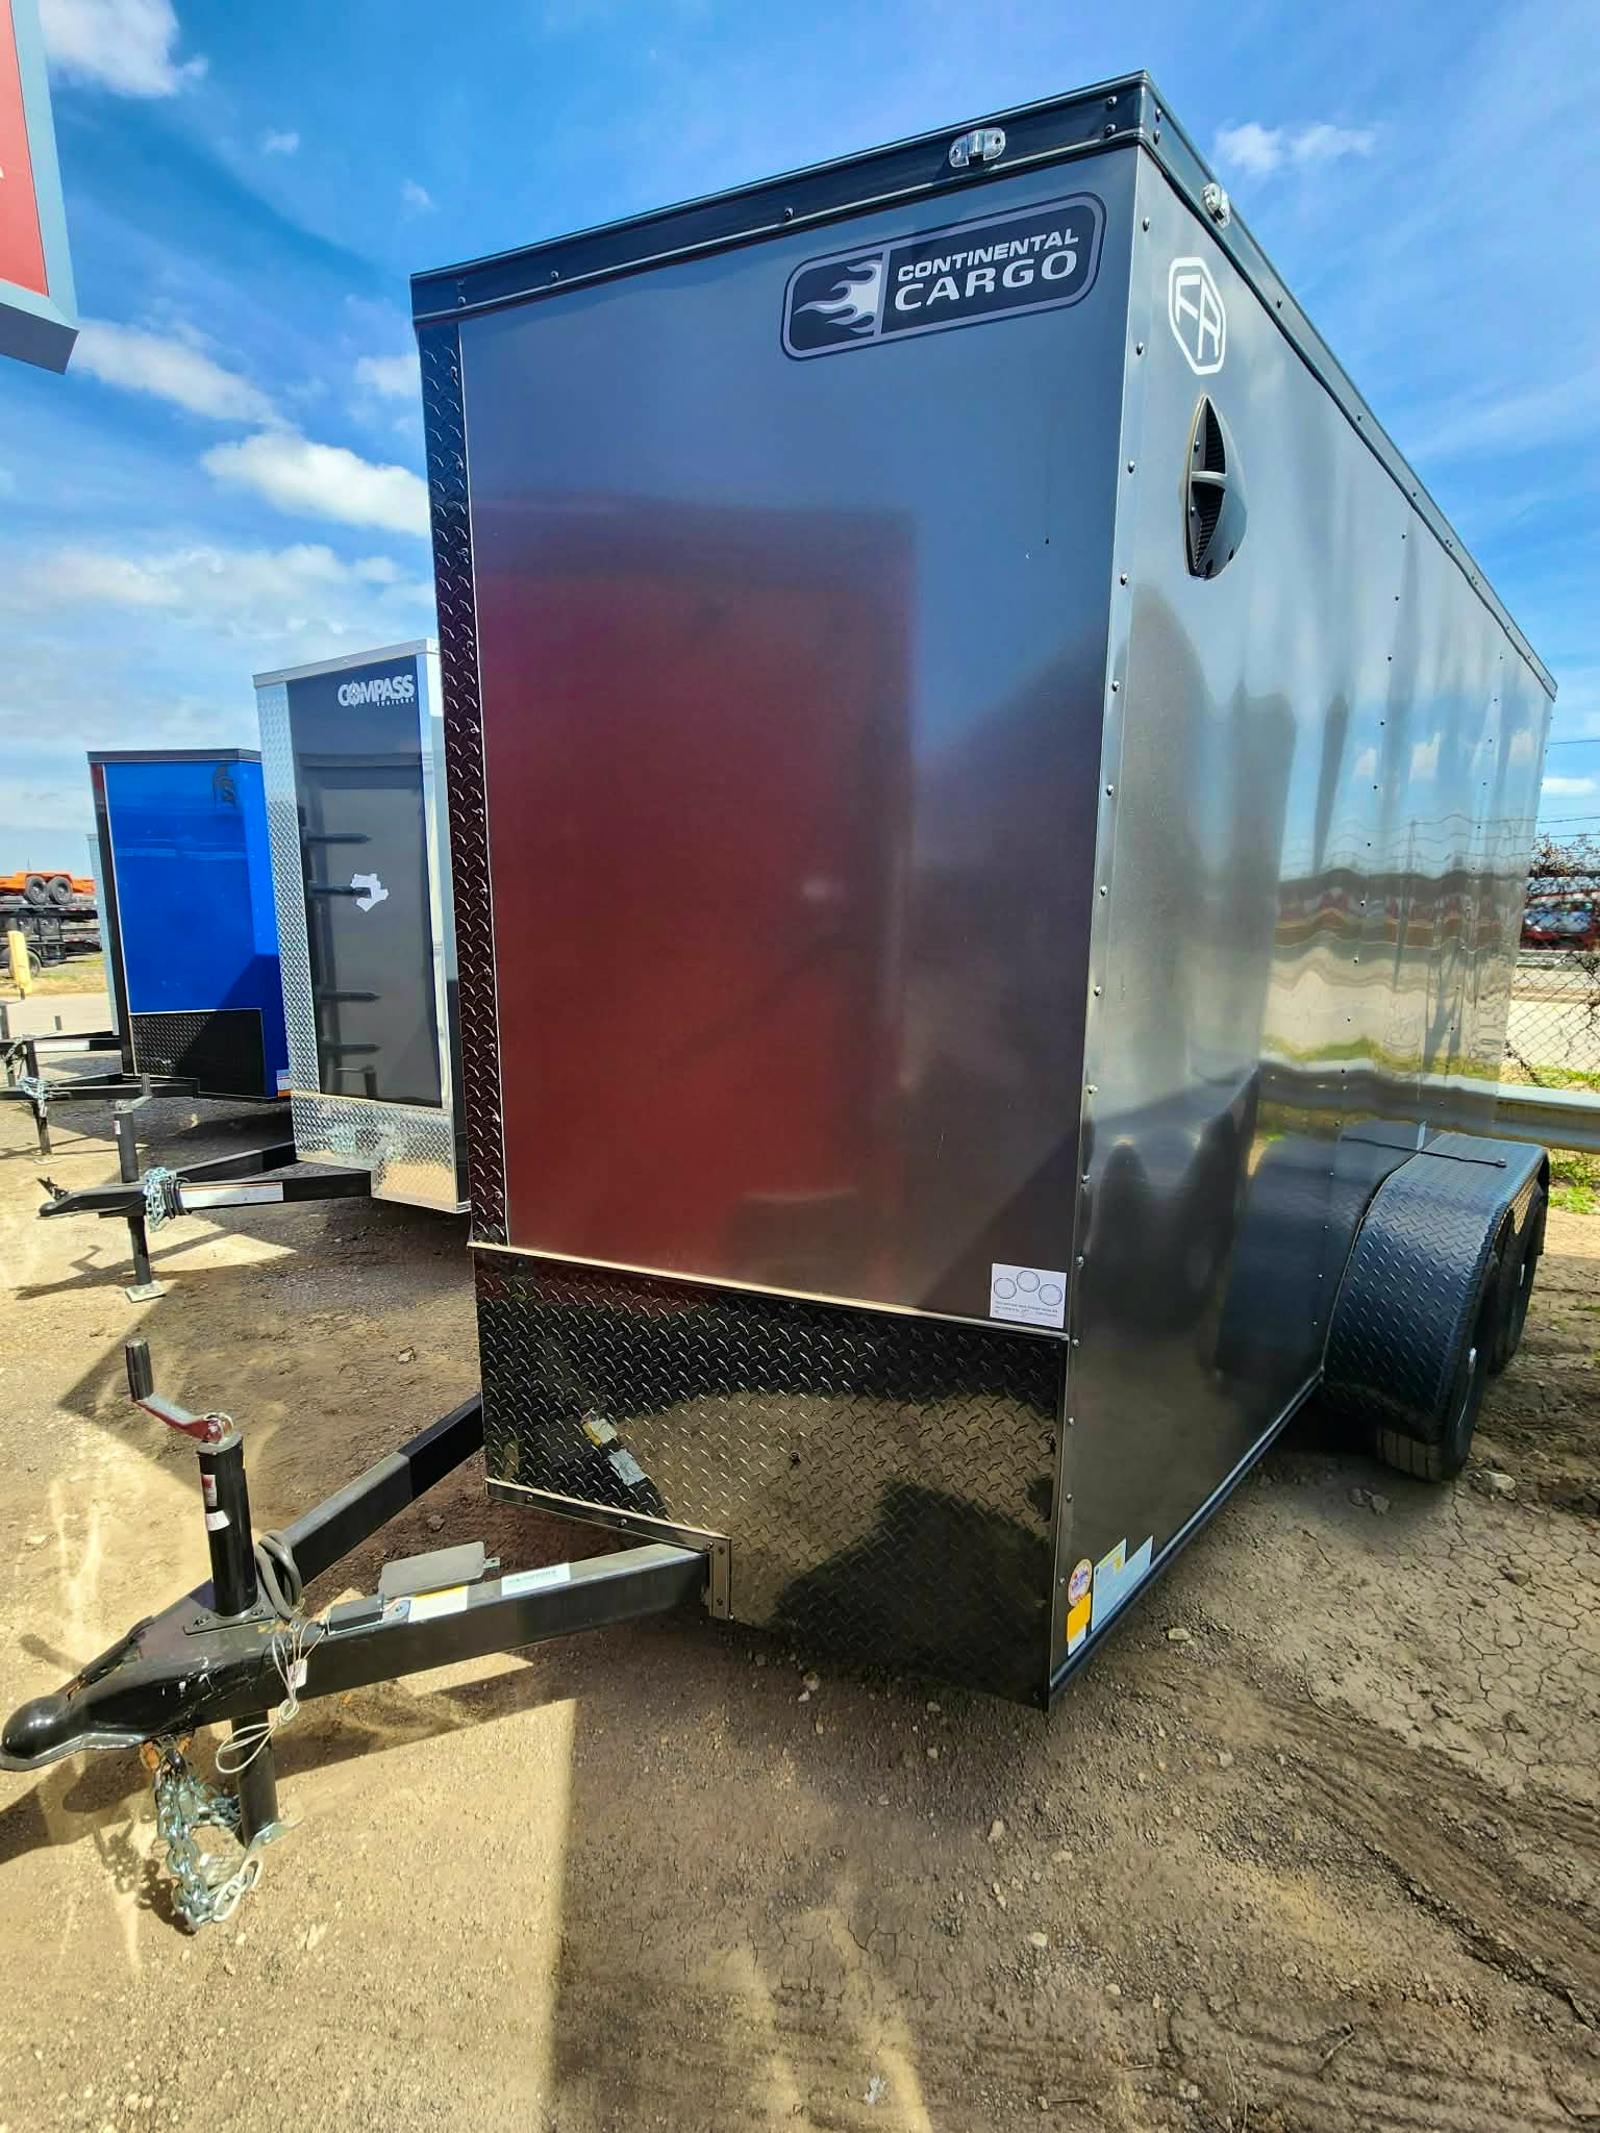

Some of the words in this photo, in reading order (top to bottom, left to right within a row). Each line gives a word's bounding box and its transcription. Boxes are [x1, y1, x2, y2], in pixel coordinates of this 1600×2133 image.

[894, 250, 1077, 311] CARGO
[897, 228, 1079, 282] CONTINENTAL
[337, 674, 415, 707] COMPASS
